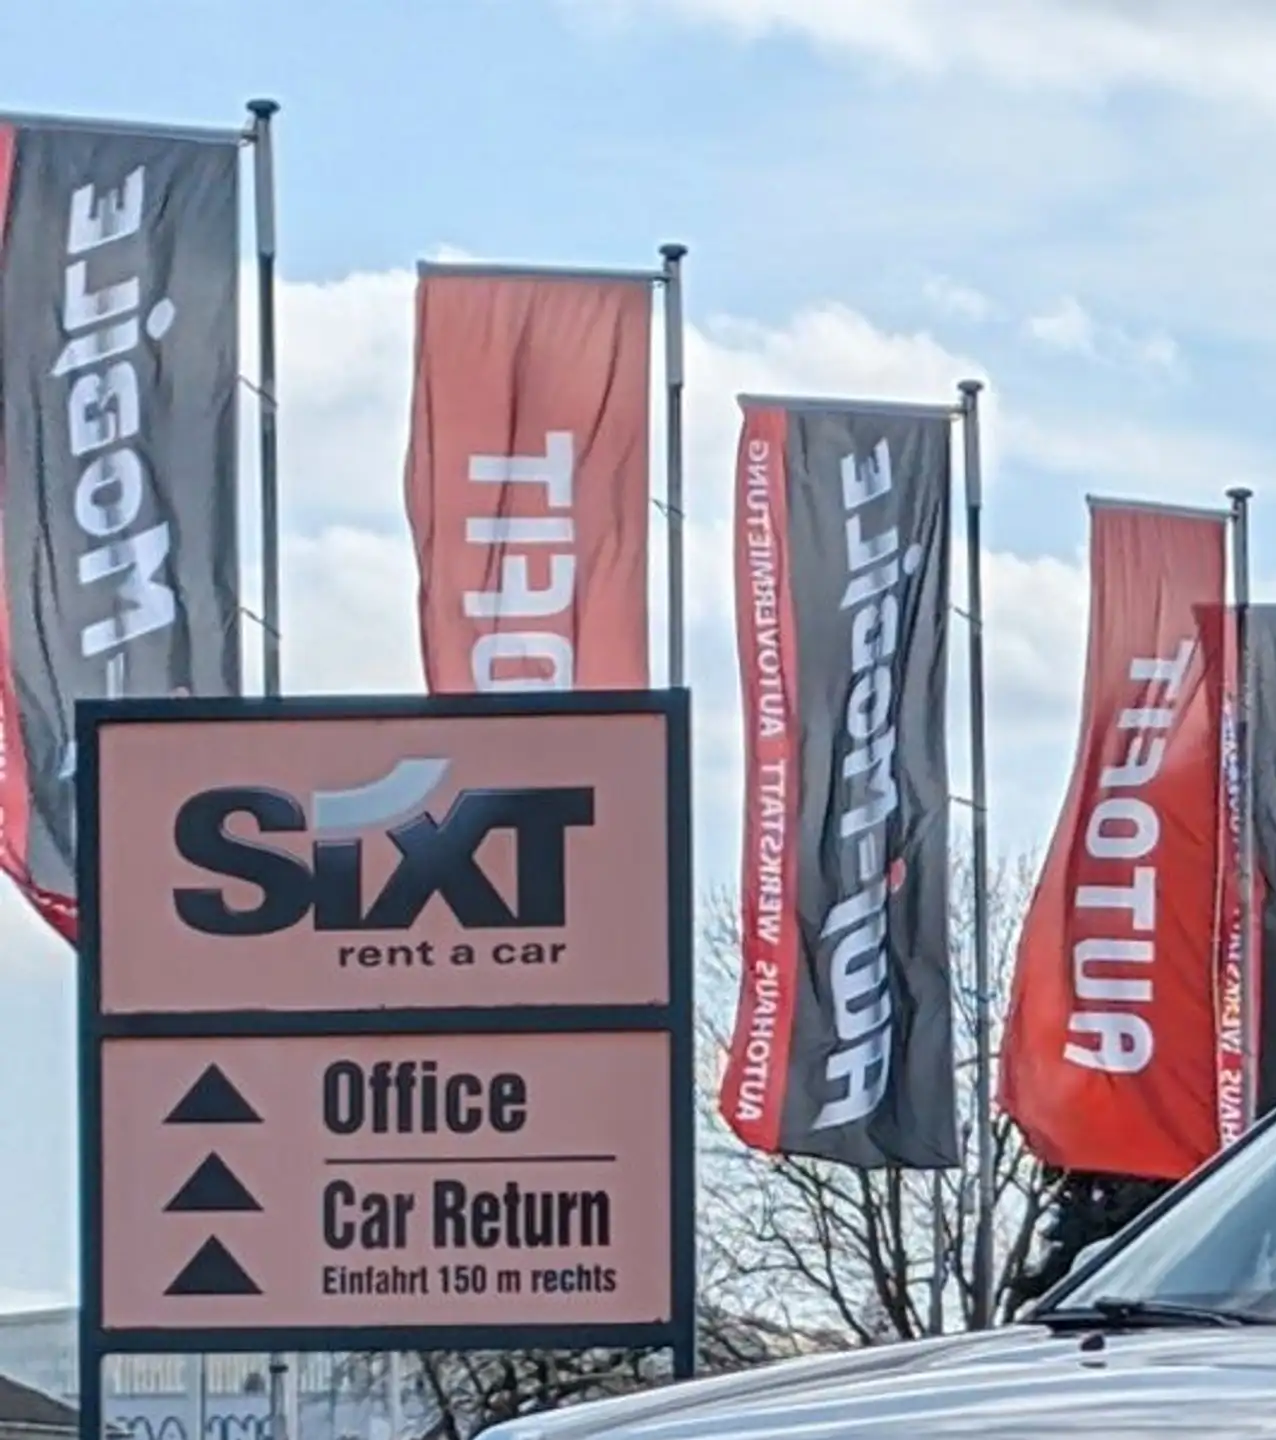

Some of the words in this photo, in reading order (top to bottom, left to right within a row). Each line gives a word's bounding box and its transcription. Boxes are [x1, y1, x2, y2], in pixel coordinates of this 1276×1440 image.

[339, 939, 435, 967] rent
[449, 943, 476, 966] a
[491, 939, 566, 965] car
[323, 1060, 528, 1134] Office
[323, 1180, 414, 1249] Car
[433, 1180, 610, 1249] Return
[323, 1265, 428, 1296] Einfahrt
[438, 1265, 487, 1294] 150
[497, 1271, 521, 1294] m
[531, 1264, 617, 1293] rechts
